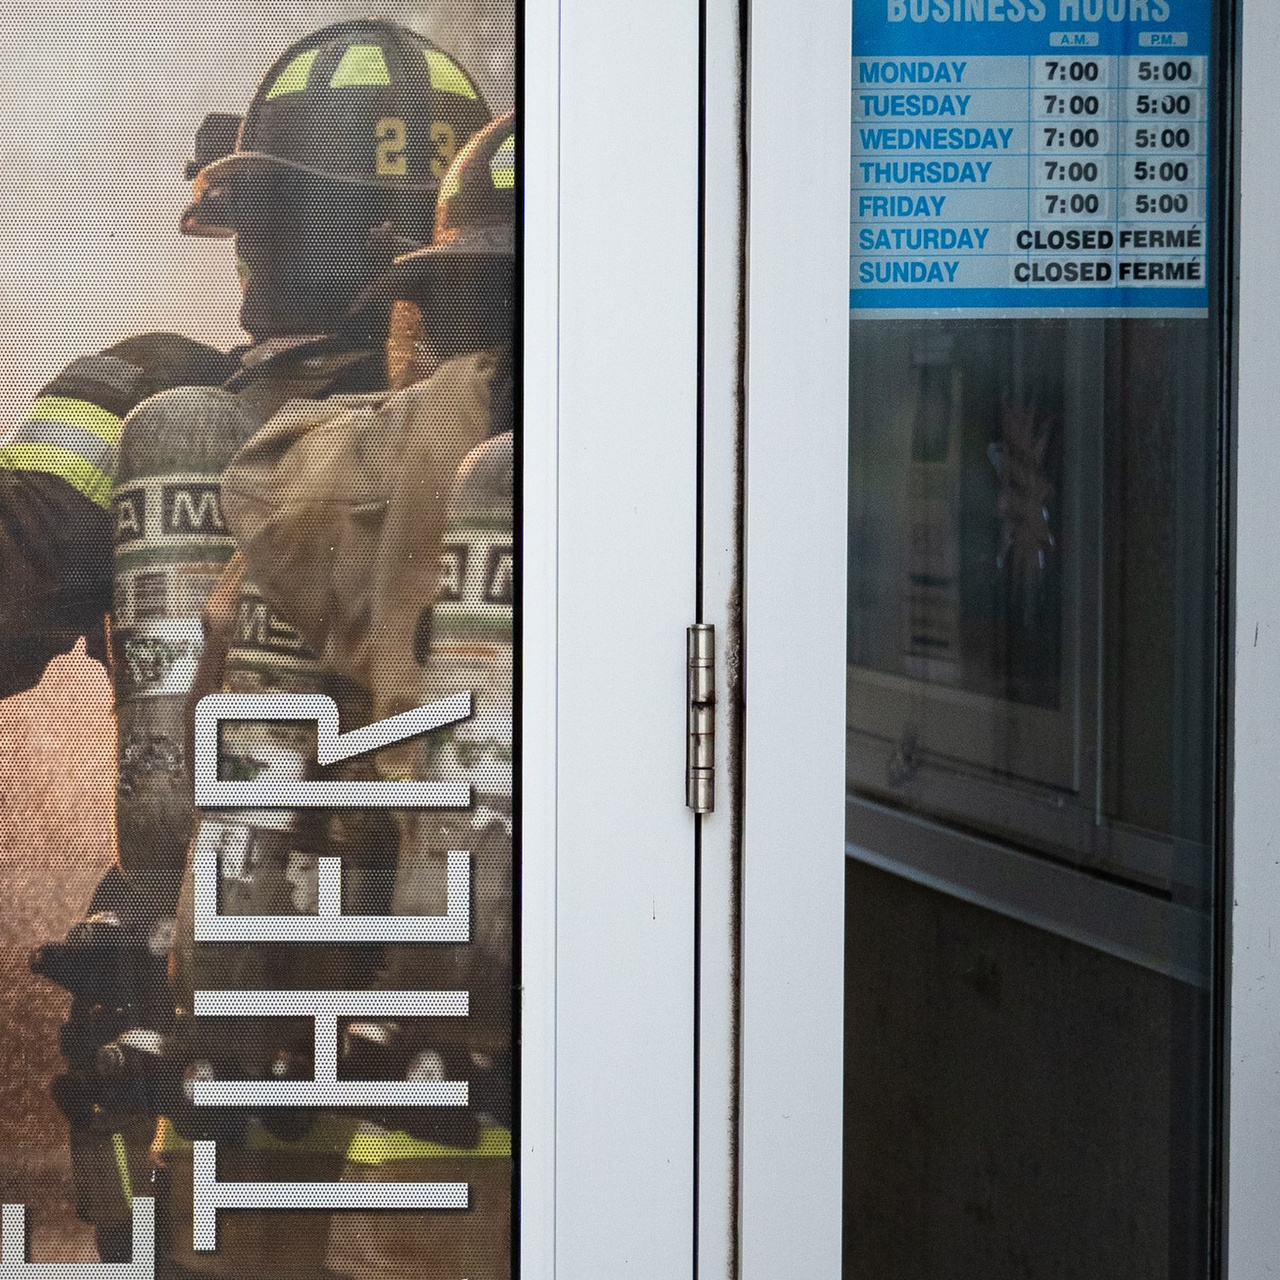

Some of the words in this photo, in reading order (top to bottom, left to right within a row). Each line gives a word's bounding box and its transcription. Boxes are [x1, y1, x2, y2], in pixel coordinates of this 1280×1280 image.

[1059, 33, 1090, 46] A.M.
[1149, 33, 1177, 46] P.M.
[858, 61, 968, 83] MONDAY
[1045, 61, 1099, 82] 7:00
[1137, 61, 1192, 82] 5:00
[859, 94, 972, 116] TUESDAY
[1044, 95, 1099, 115] 7:00
[1135, 95, 1191, 115] 5:00
[859, 128, 1014, 150] WEDNESDAY
[1043, 128, 1099, 148] 7:00
[1134, 128, 1190, 148] 5:00
[859, 161, 993, 183] THURSDAY
[1044, 162, 1098, 181] 7:00
[1134, 162, 1188, 181] 5:00
[858, 195, 947, 217] FRIDAY
[1045, 194, 1099, 214] 7:00
[1135, 194, 1188, 214] 5:00
[858, 228, 990, 250] SATURDAY
[1016, 229, 1114, 250] CLOSED
[1120, 224, 1201, 248] FERMÉ
[858, 261, 960, 284] SUNDAY
[1014, 261, 1112, 282] CLOSED
[1119, 256, 1201, 281] FERMÉ
